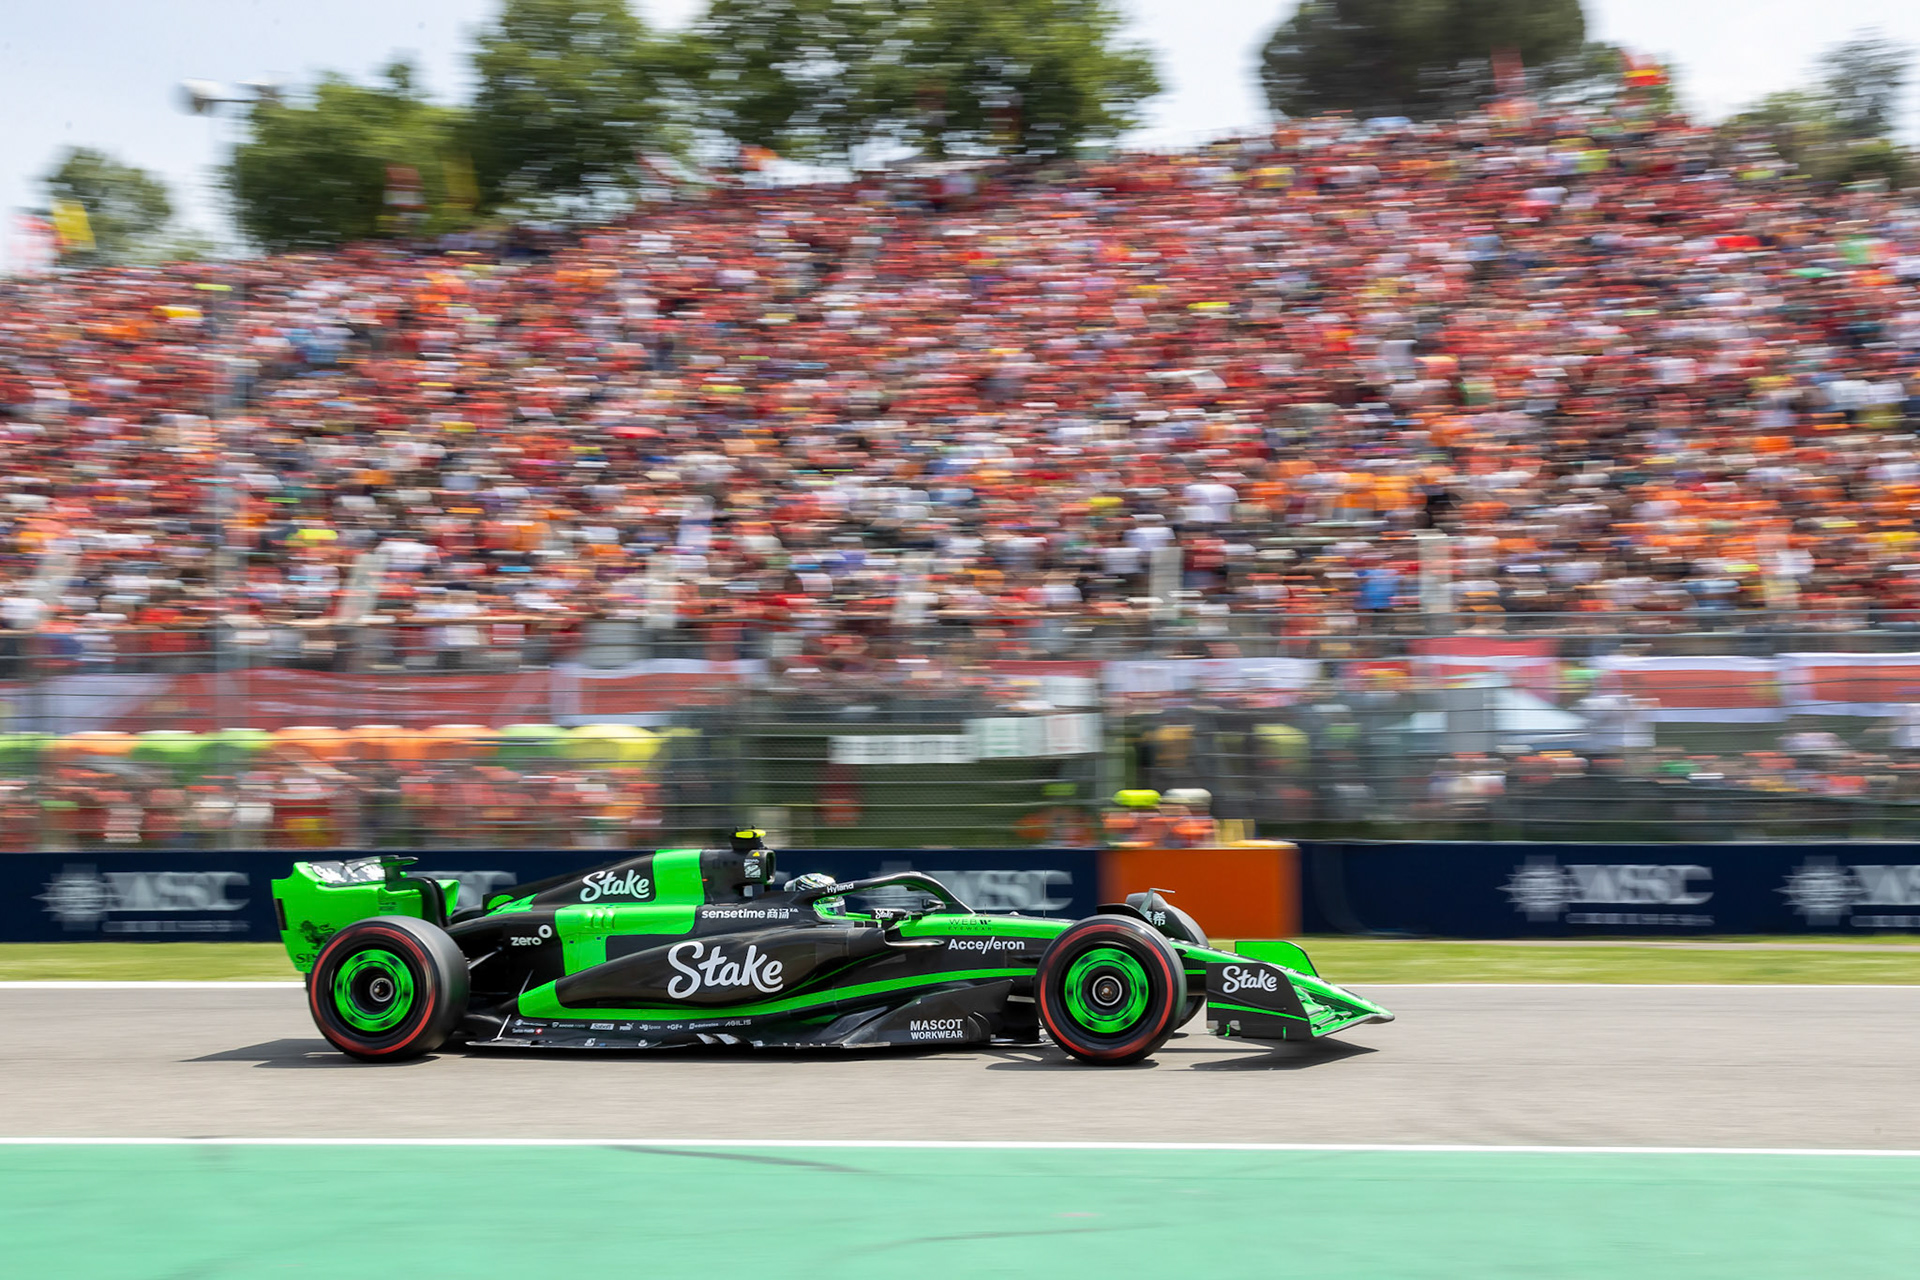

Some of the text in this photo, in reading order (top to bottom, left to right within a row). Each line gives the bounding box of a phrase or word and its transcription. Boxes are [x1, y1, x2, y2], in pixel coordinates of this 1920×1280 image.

[579, 869, 650, 902] Stake
[826, 882, 855, 894] Hyland
[701, 908, 766, 919] sensetime
[667, 941, 784, 999] Stake
[1222, 965, 1277, 993] Stake
[910, 1019, 963, 1031] MASCOT
[911, 1031, 963, 1040] WORKWEAR
